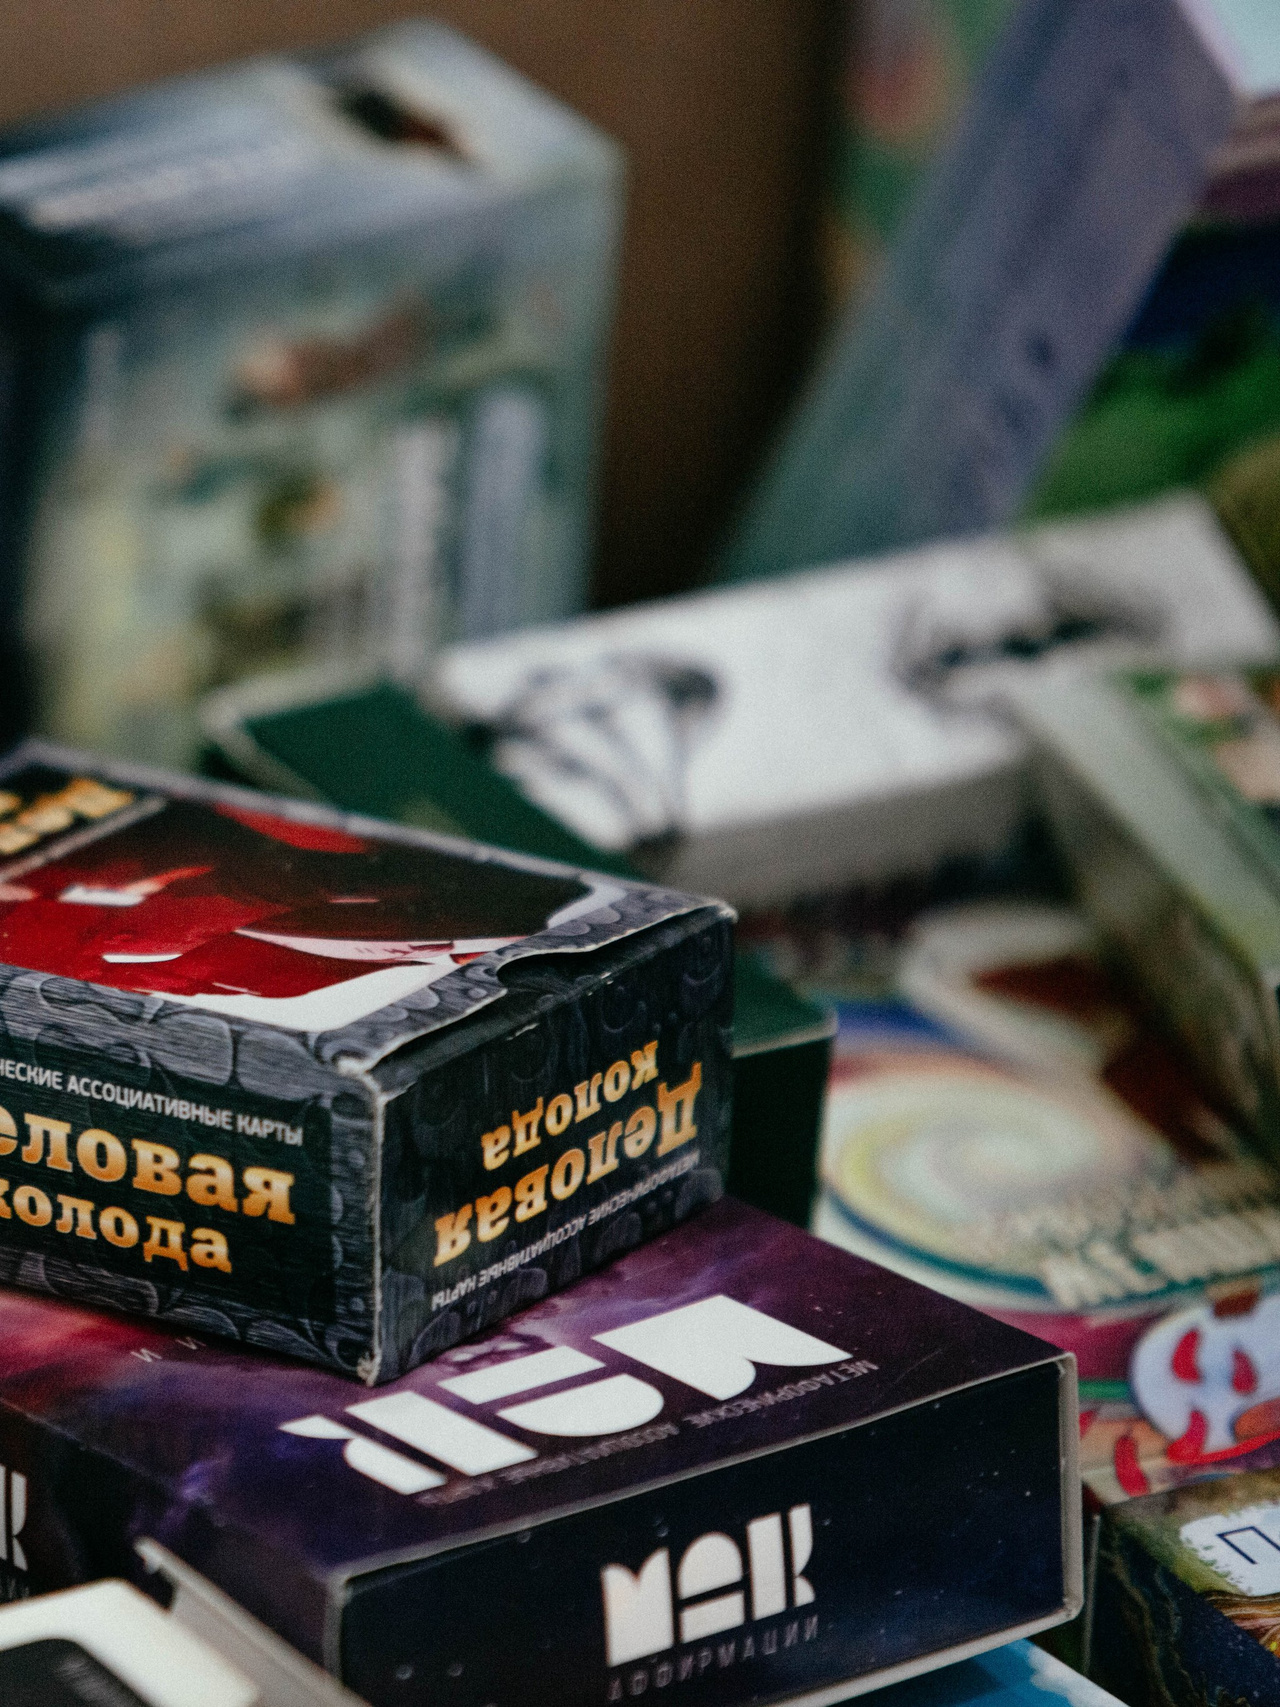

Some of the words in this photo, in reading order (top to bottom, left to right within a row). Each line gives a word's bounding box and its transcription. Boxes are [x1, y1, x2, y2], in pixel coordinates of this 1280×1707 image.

[66, 1075, 233, 1131] АССОЦИАТИВНЫЕ
[236, 1113, 304, 1147] КАРТЫ
[433, 1061, 702, 1267] Деловая
[480, 1039, 659, 1171] колода
